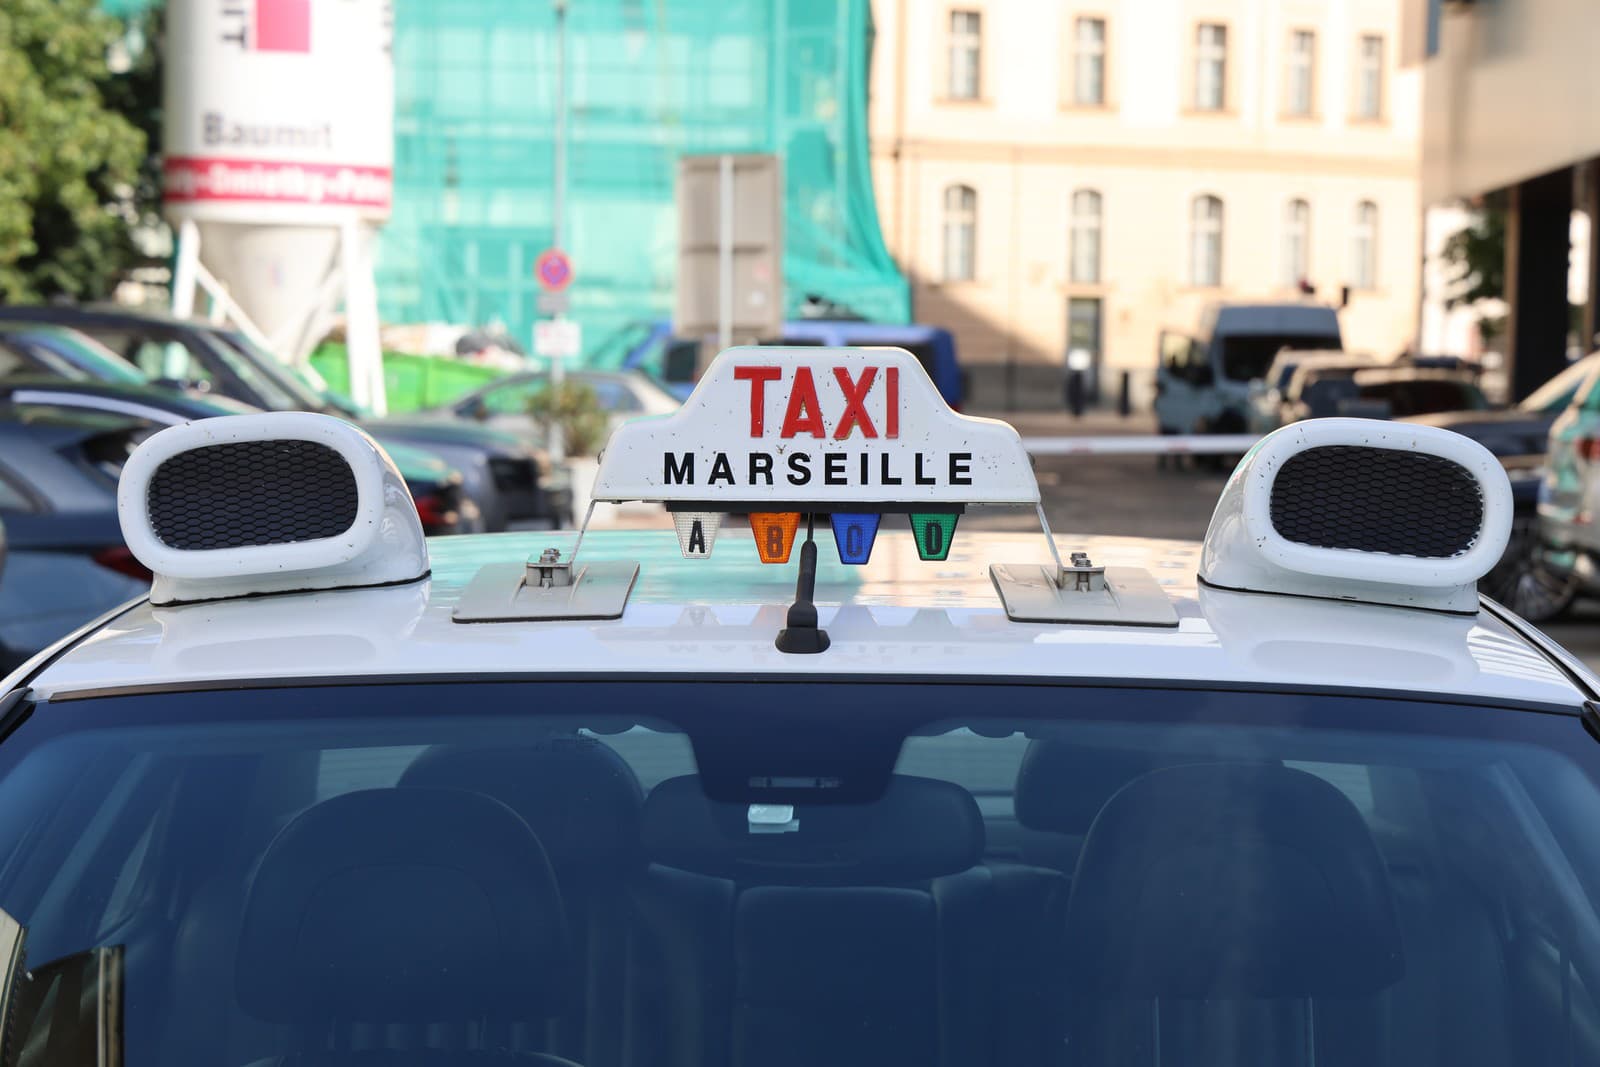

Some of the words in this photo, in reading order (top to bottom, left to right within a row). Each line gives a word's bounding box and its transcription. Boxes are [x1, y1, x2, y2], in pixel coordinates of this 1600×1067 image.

[203, 112, 333, 149] Baumit
[734, 366, 899, 439] TAXI
[664, 452, 972, 486] MARSEILLE
[688, 520, 706, 554] A
[766, 525, 784, 559] B
[846, 524, 863, 558] C
[925, 521, 943, 556] D
